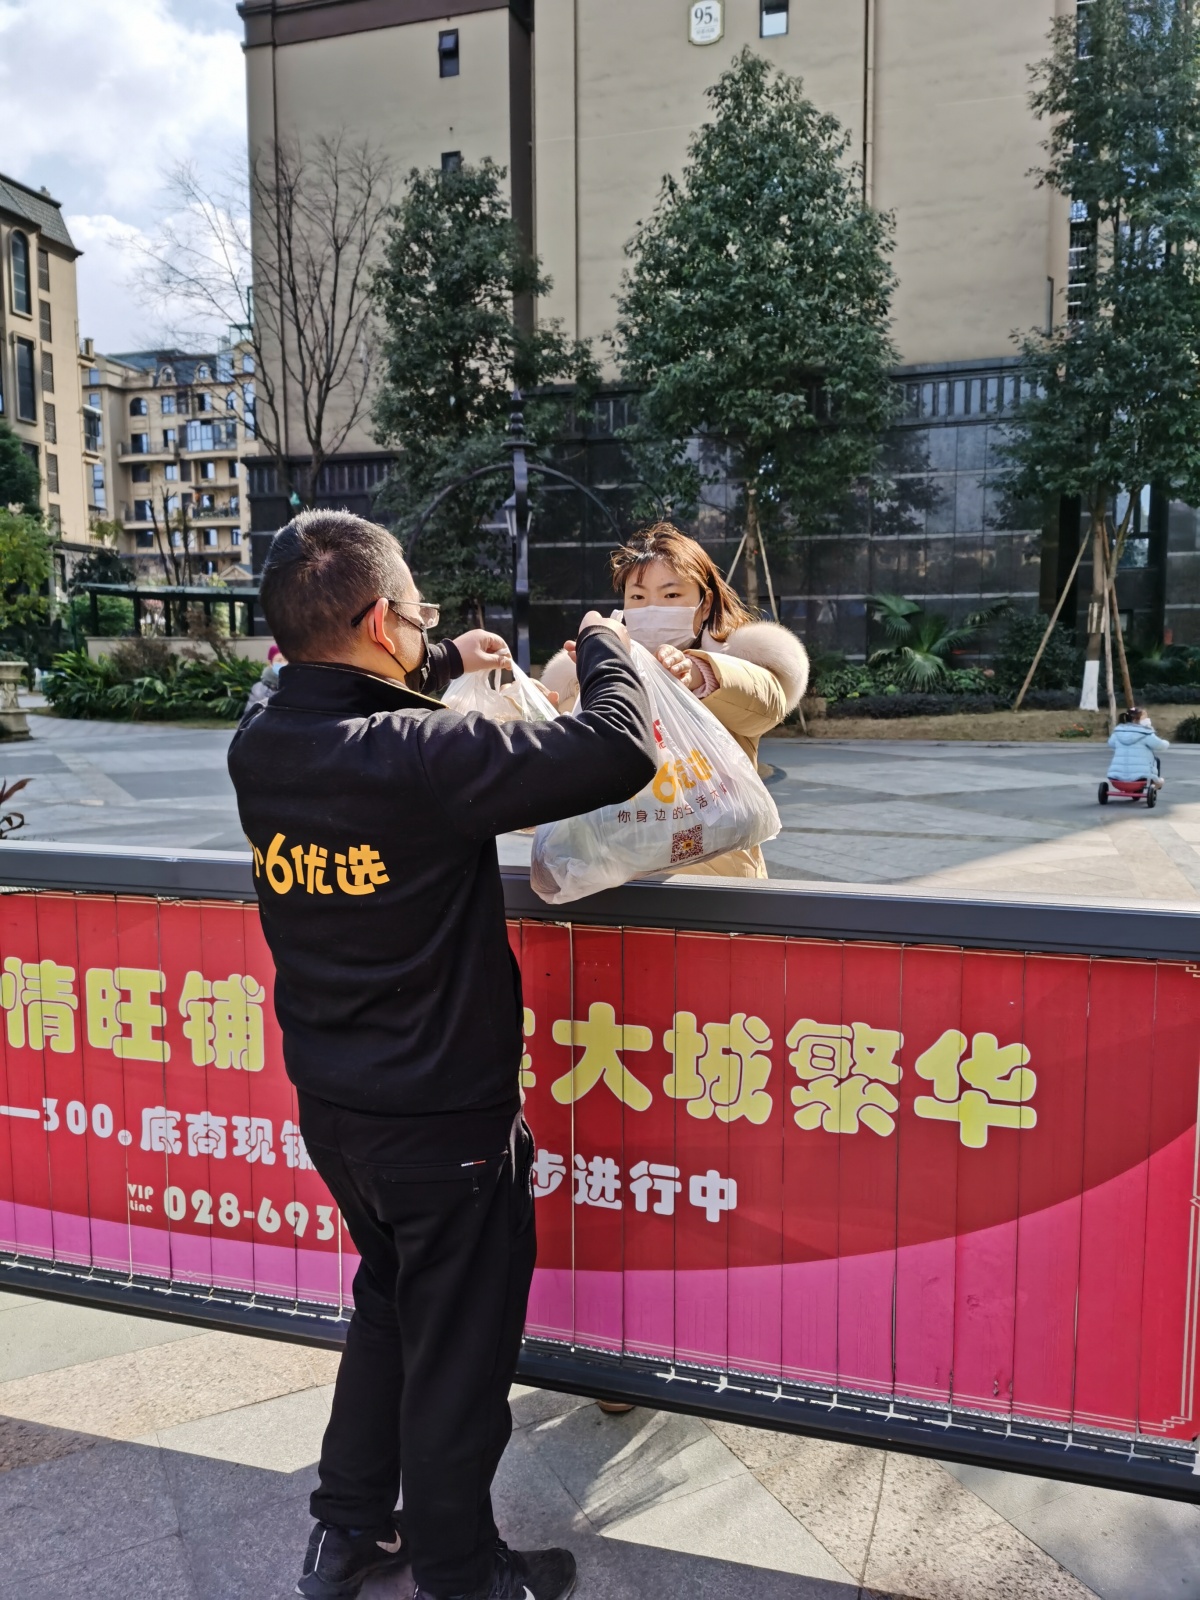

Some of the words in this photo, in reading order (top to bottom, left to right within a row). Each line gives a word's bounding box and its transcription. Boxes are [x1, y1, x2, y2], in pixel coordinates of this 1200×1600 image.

[694, 6, 713, 25] 95
[0, 956, 266, 1072] 情旺铺
[518, 1001, 1037, 1148] 大城繁华
[127, 1183, 154, 1200] VIP
[129, 1199, 153, 1213] Line
[163, 1185, 350, 1241] 028-693
